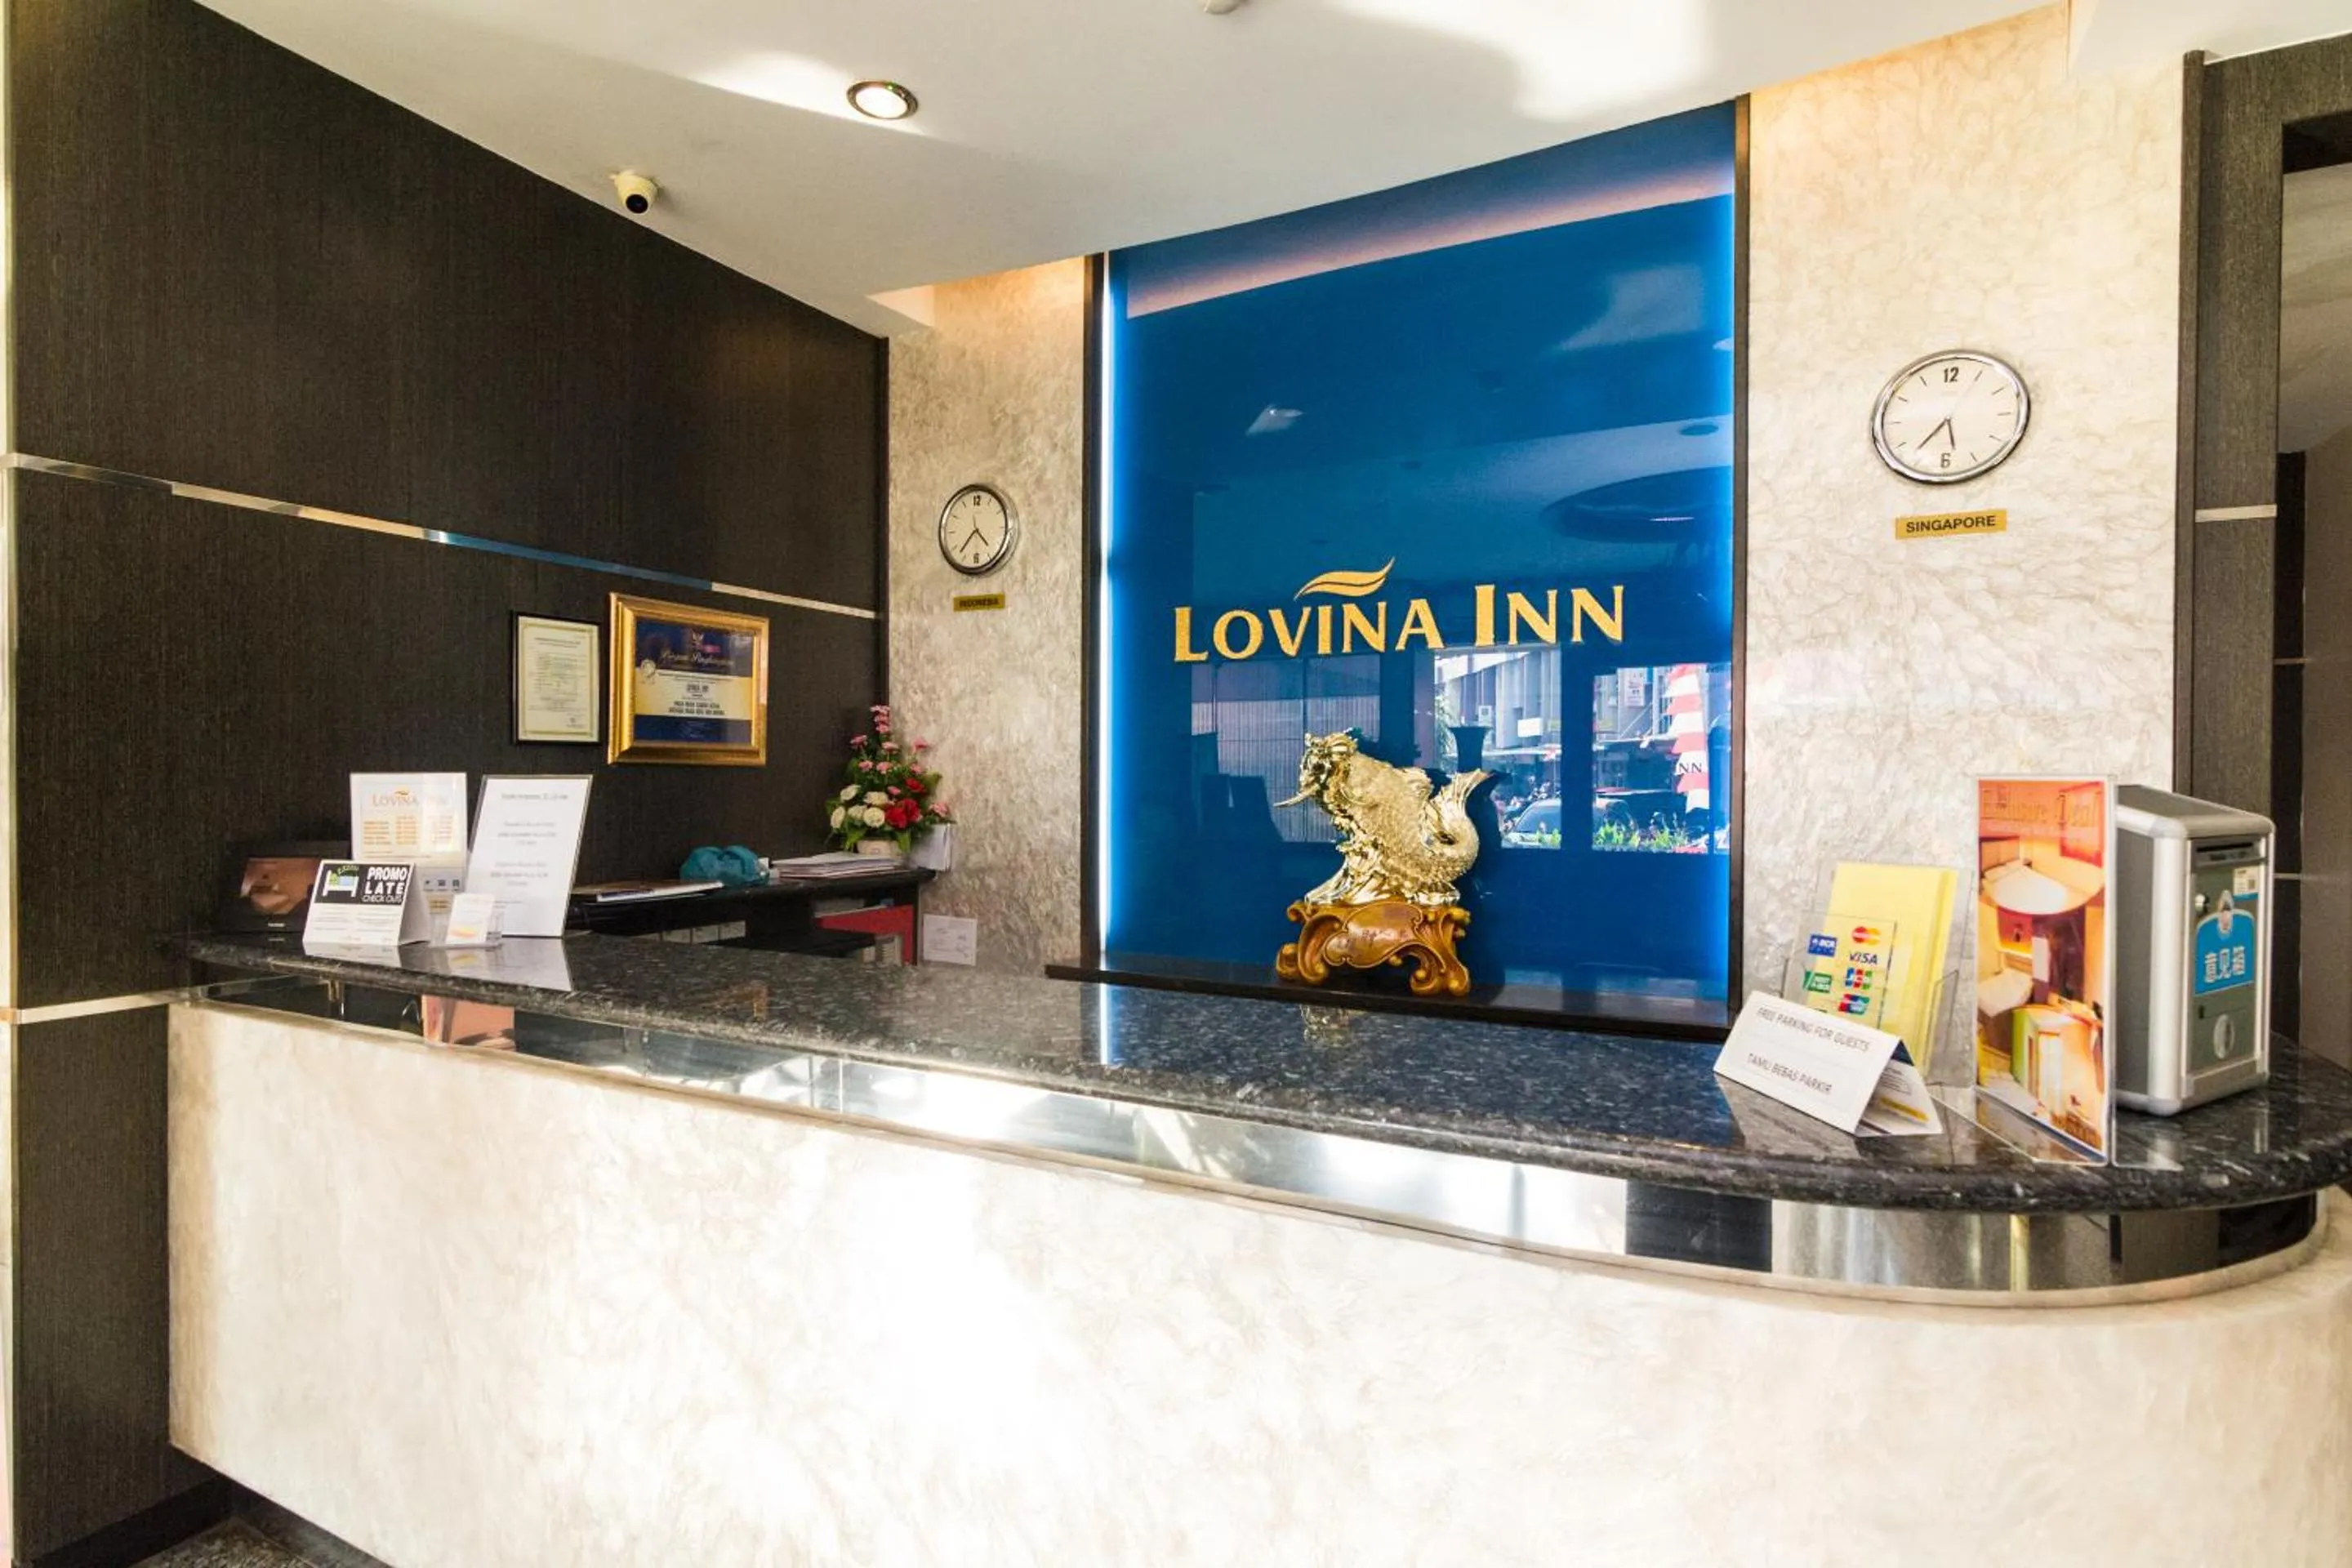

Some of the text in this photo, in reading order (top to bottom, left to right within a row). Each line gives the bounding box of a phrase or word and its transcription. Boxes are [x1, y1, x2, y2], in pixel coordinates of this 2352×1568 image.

[1943, 367, 1959, 383] 12
[1940, 452, 1951, 469] 6
[973, 495, 981, 506] 12
[1905, 515, 1996, 533] SINGAPORE
[1174, 599, 1446, 662] LOVINA
[367, 866, 408, 880] PROMO
[364, 880, 405, 894] LATE
[1849, 951, 1878, 964] VISA
[1777, 1013, 1814, 1034] PARKING
[1814, 1026, 1833, 1040] FOR
[1834, 1032, 1870, 1053] GUESTS
